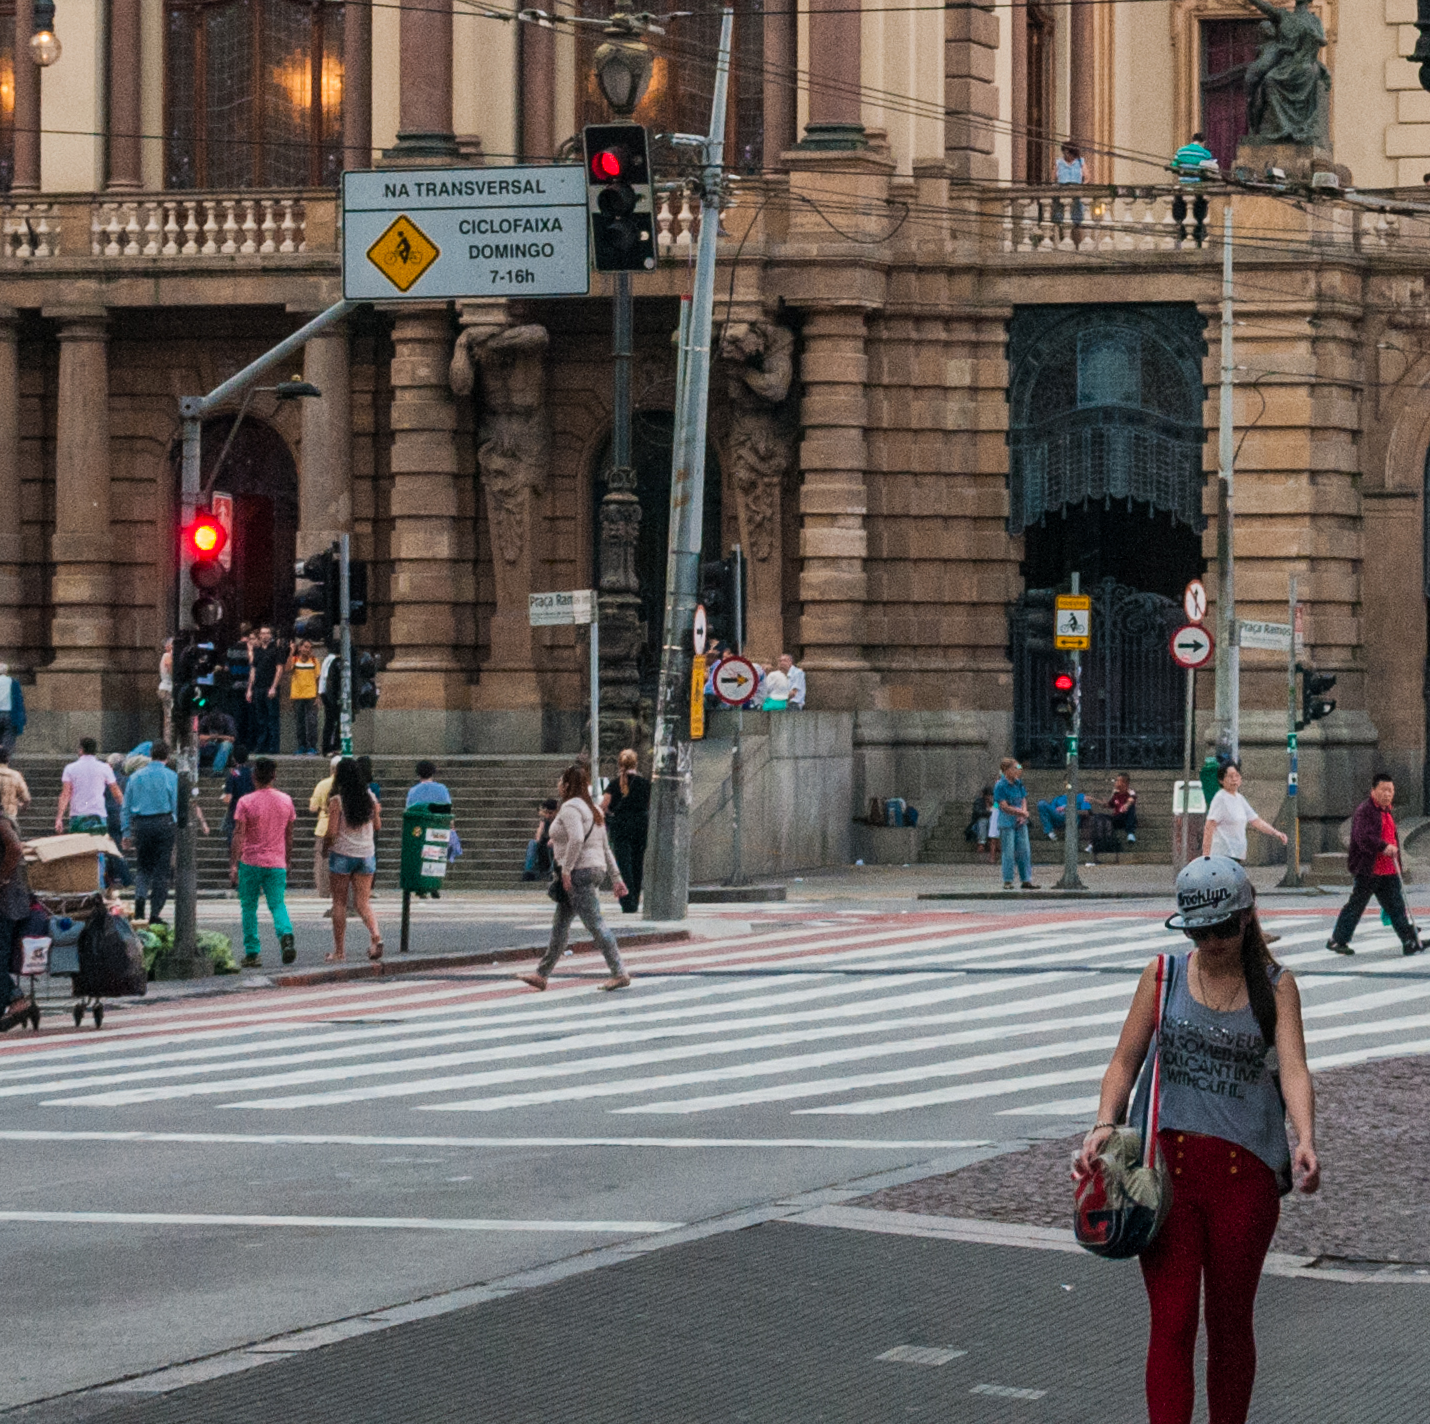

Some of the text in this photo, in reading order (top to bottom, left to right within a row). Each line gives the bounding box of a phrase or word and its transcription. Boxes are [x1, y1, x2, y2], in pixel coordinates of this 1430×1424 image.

[384, 179, 546, 198] NA TRANSVERSAL
[458, 217, 563, 235] CICLOFAIXA
[468, 242, 555, 259] DOMINGO
[489, 270, 535, 284] 7-16h
